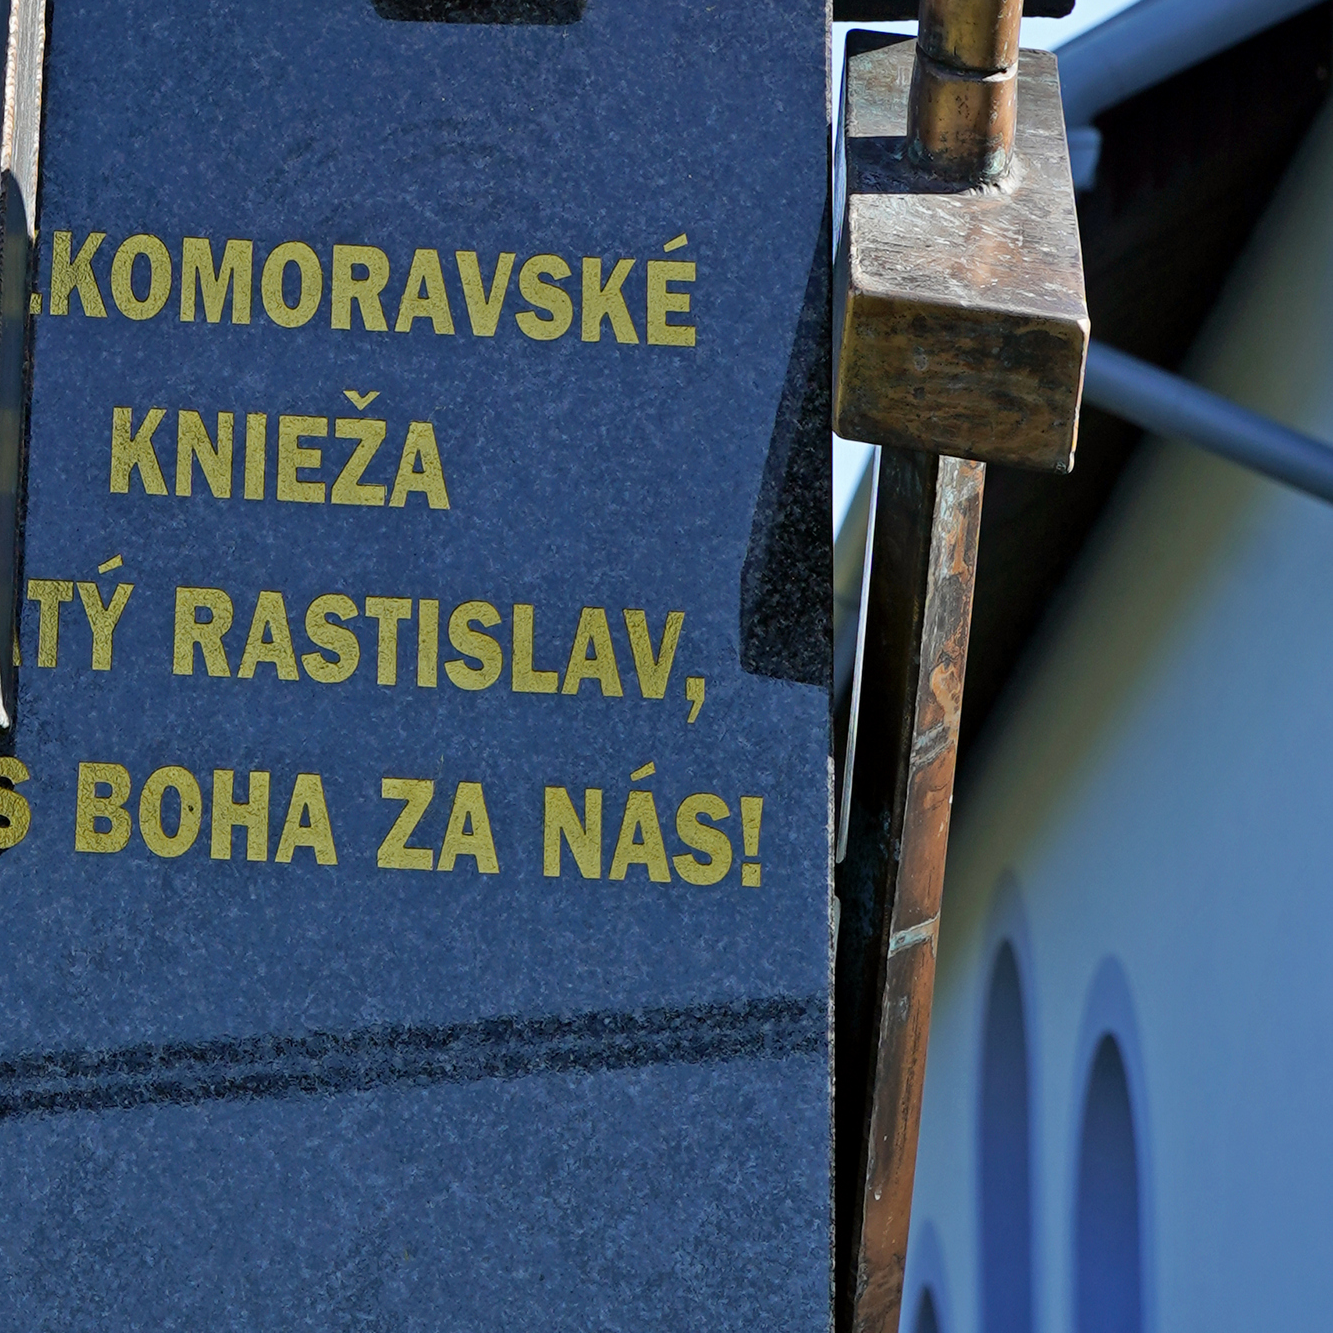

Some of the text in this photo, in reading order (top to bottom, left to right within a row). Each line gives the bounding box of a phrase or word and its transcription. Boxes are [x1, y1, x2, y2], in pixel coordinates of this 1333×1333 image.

[30, 229, 696, 347] KOMORAVSKÉ
[110, 391, 449, 511] KNIEŽA
[13, 554, 706, 724] TÝ RASTISLAV,
[74, 761, 337, 867] BOHA
[377, 776, 499, 874] ZA
[542, 762, 762, 887] NÁS!
